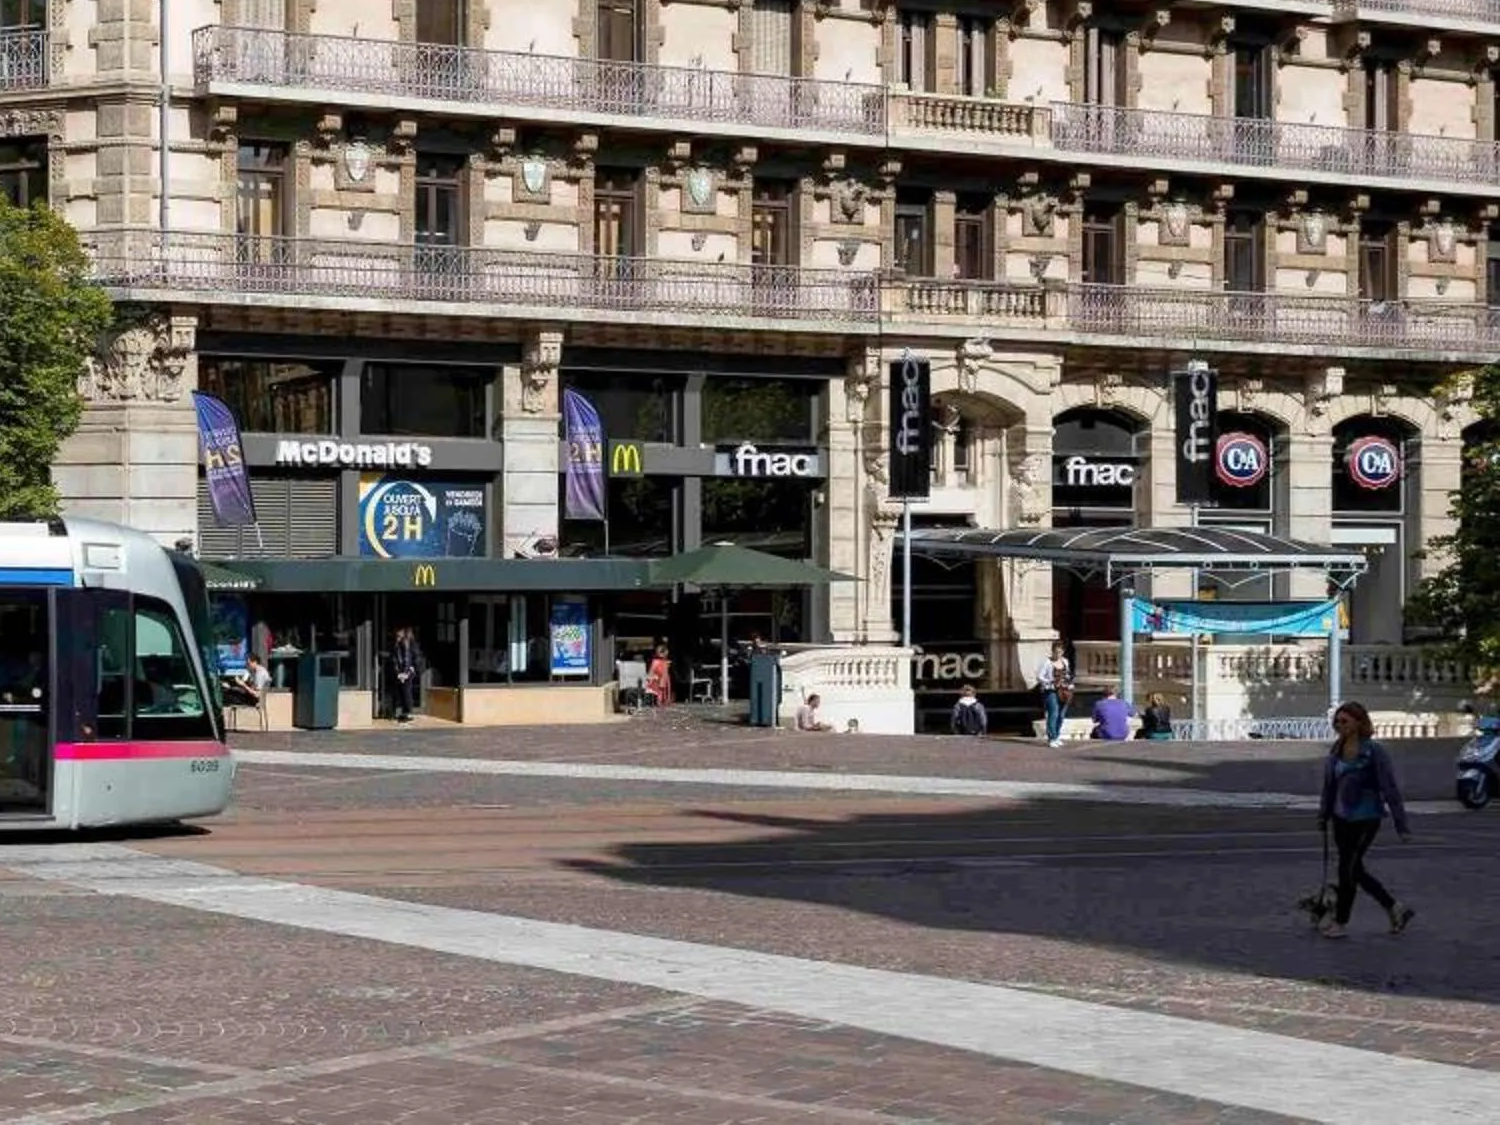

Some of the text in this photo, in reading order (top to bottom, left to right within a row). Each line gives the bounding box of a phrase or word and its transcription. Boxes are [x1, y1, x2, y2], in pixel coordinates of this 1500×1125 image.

[896, 358, 920, 455] fnac
[1183, 371, 1210, 463] fnac
[276, 440, 432, 466] McDonald's
[736, 444, 811, 476] fnac
[1066, 456, 1134, 485] fnac
